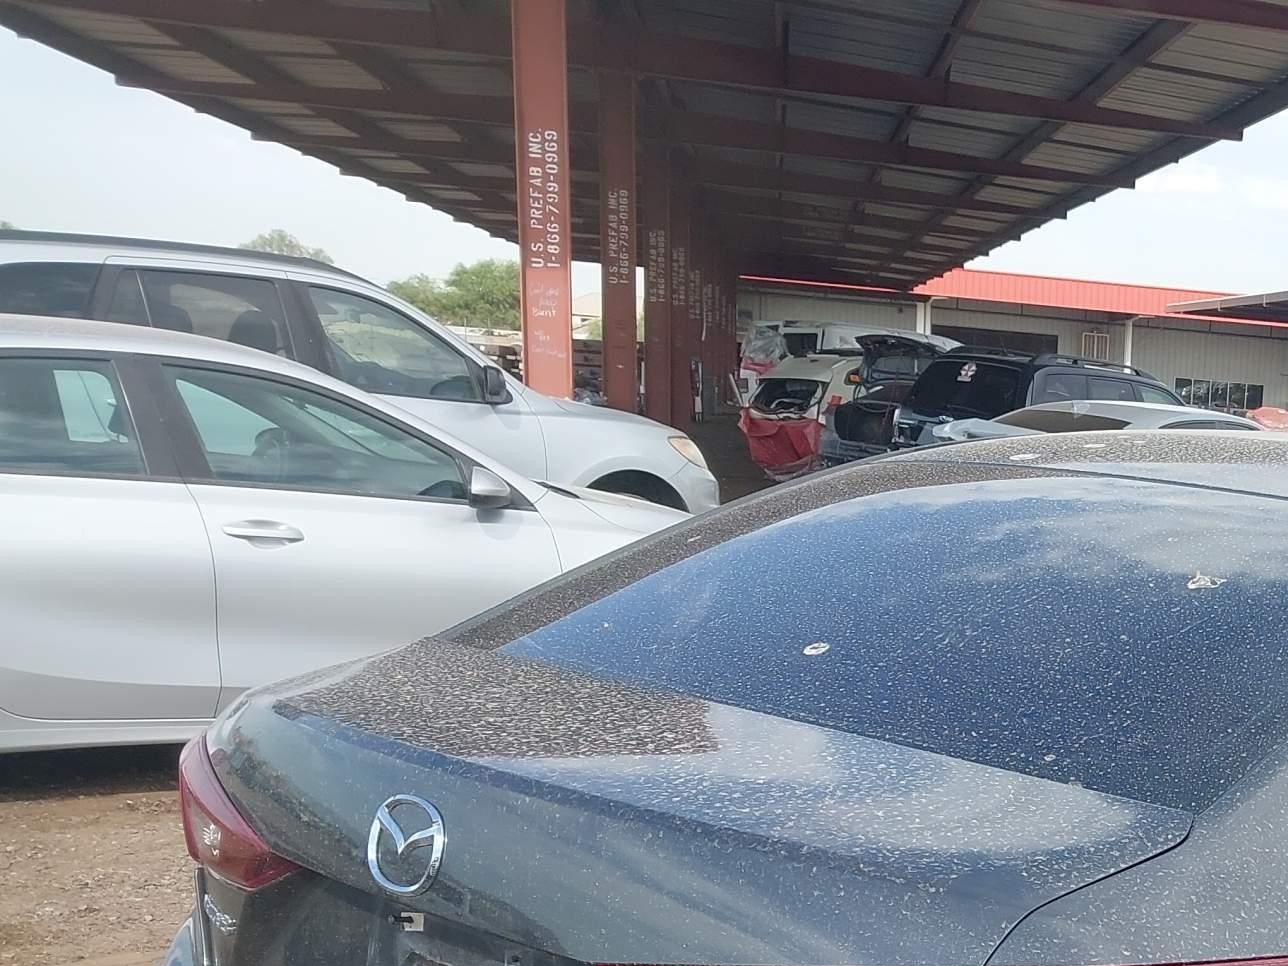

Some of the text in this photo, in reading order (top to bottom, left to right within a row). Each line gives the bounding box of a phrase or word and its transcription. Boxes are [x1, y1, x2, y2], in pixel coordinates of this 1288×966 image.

[528, 128, 544, 268] U.S. PREFAB INC.
[545, 130, 561, 268] 1-866-799-0969
[609, 215, 618, 258] PREFAB
[619, 190, 629, 284] 1-866-799-0969
[609, 265, 618, 284] U.S.
